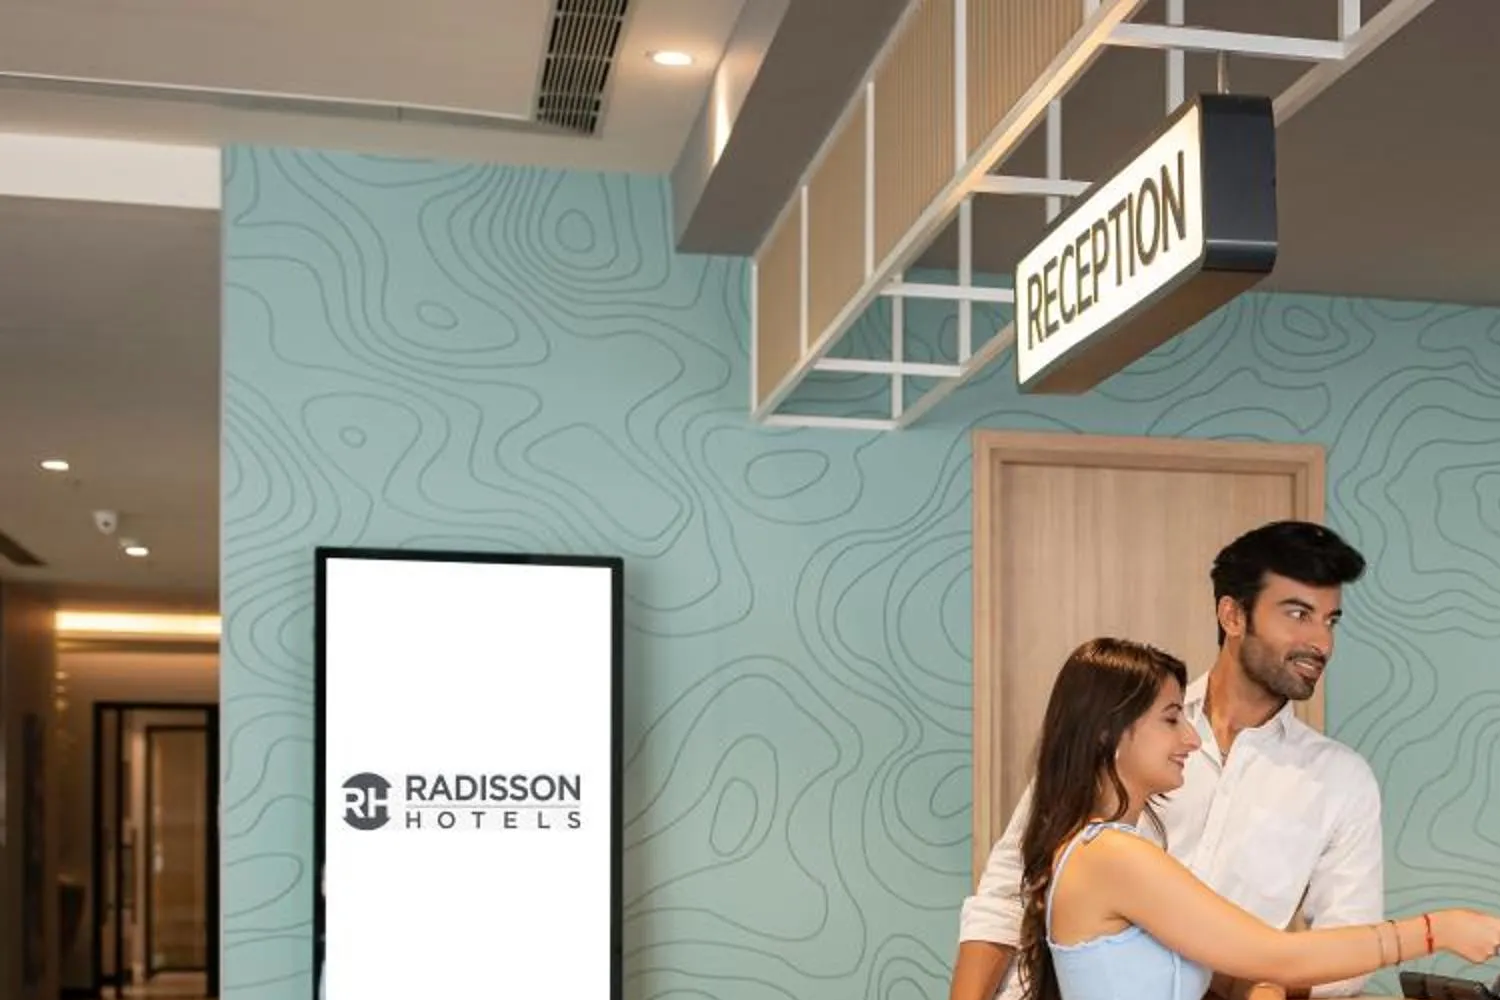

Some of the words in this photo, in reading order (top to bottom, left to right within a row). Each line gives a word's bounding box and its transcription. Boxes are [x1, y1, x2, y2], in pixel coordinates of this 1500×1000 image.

[1027, 150, 1186, 350] RECEPTION
[406, 774, 581, 801] RADISSON
[406, 811, 581, 829] HOTELS
